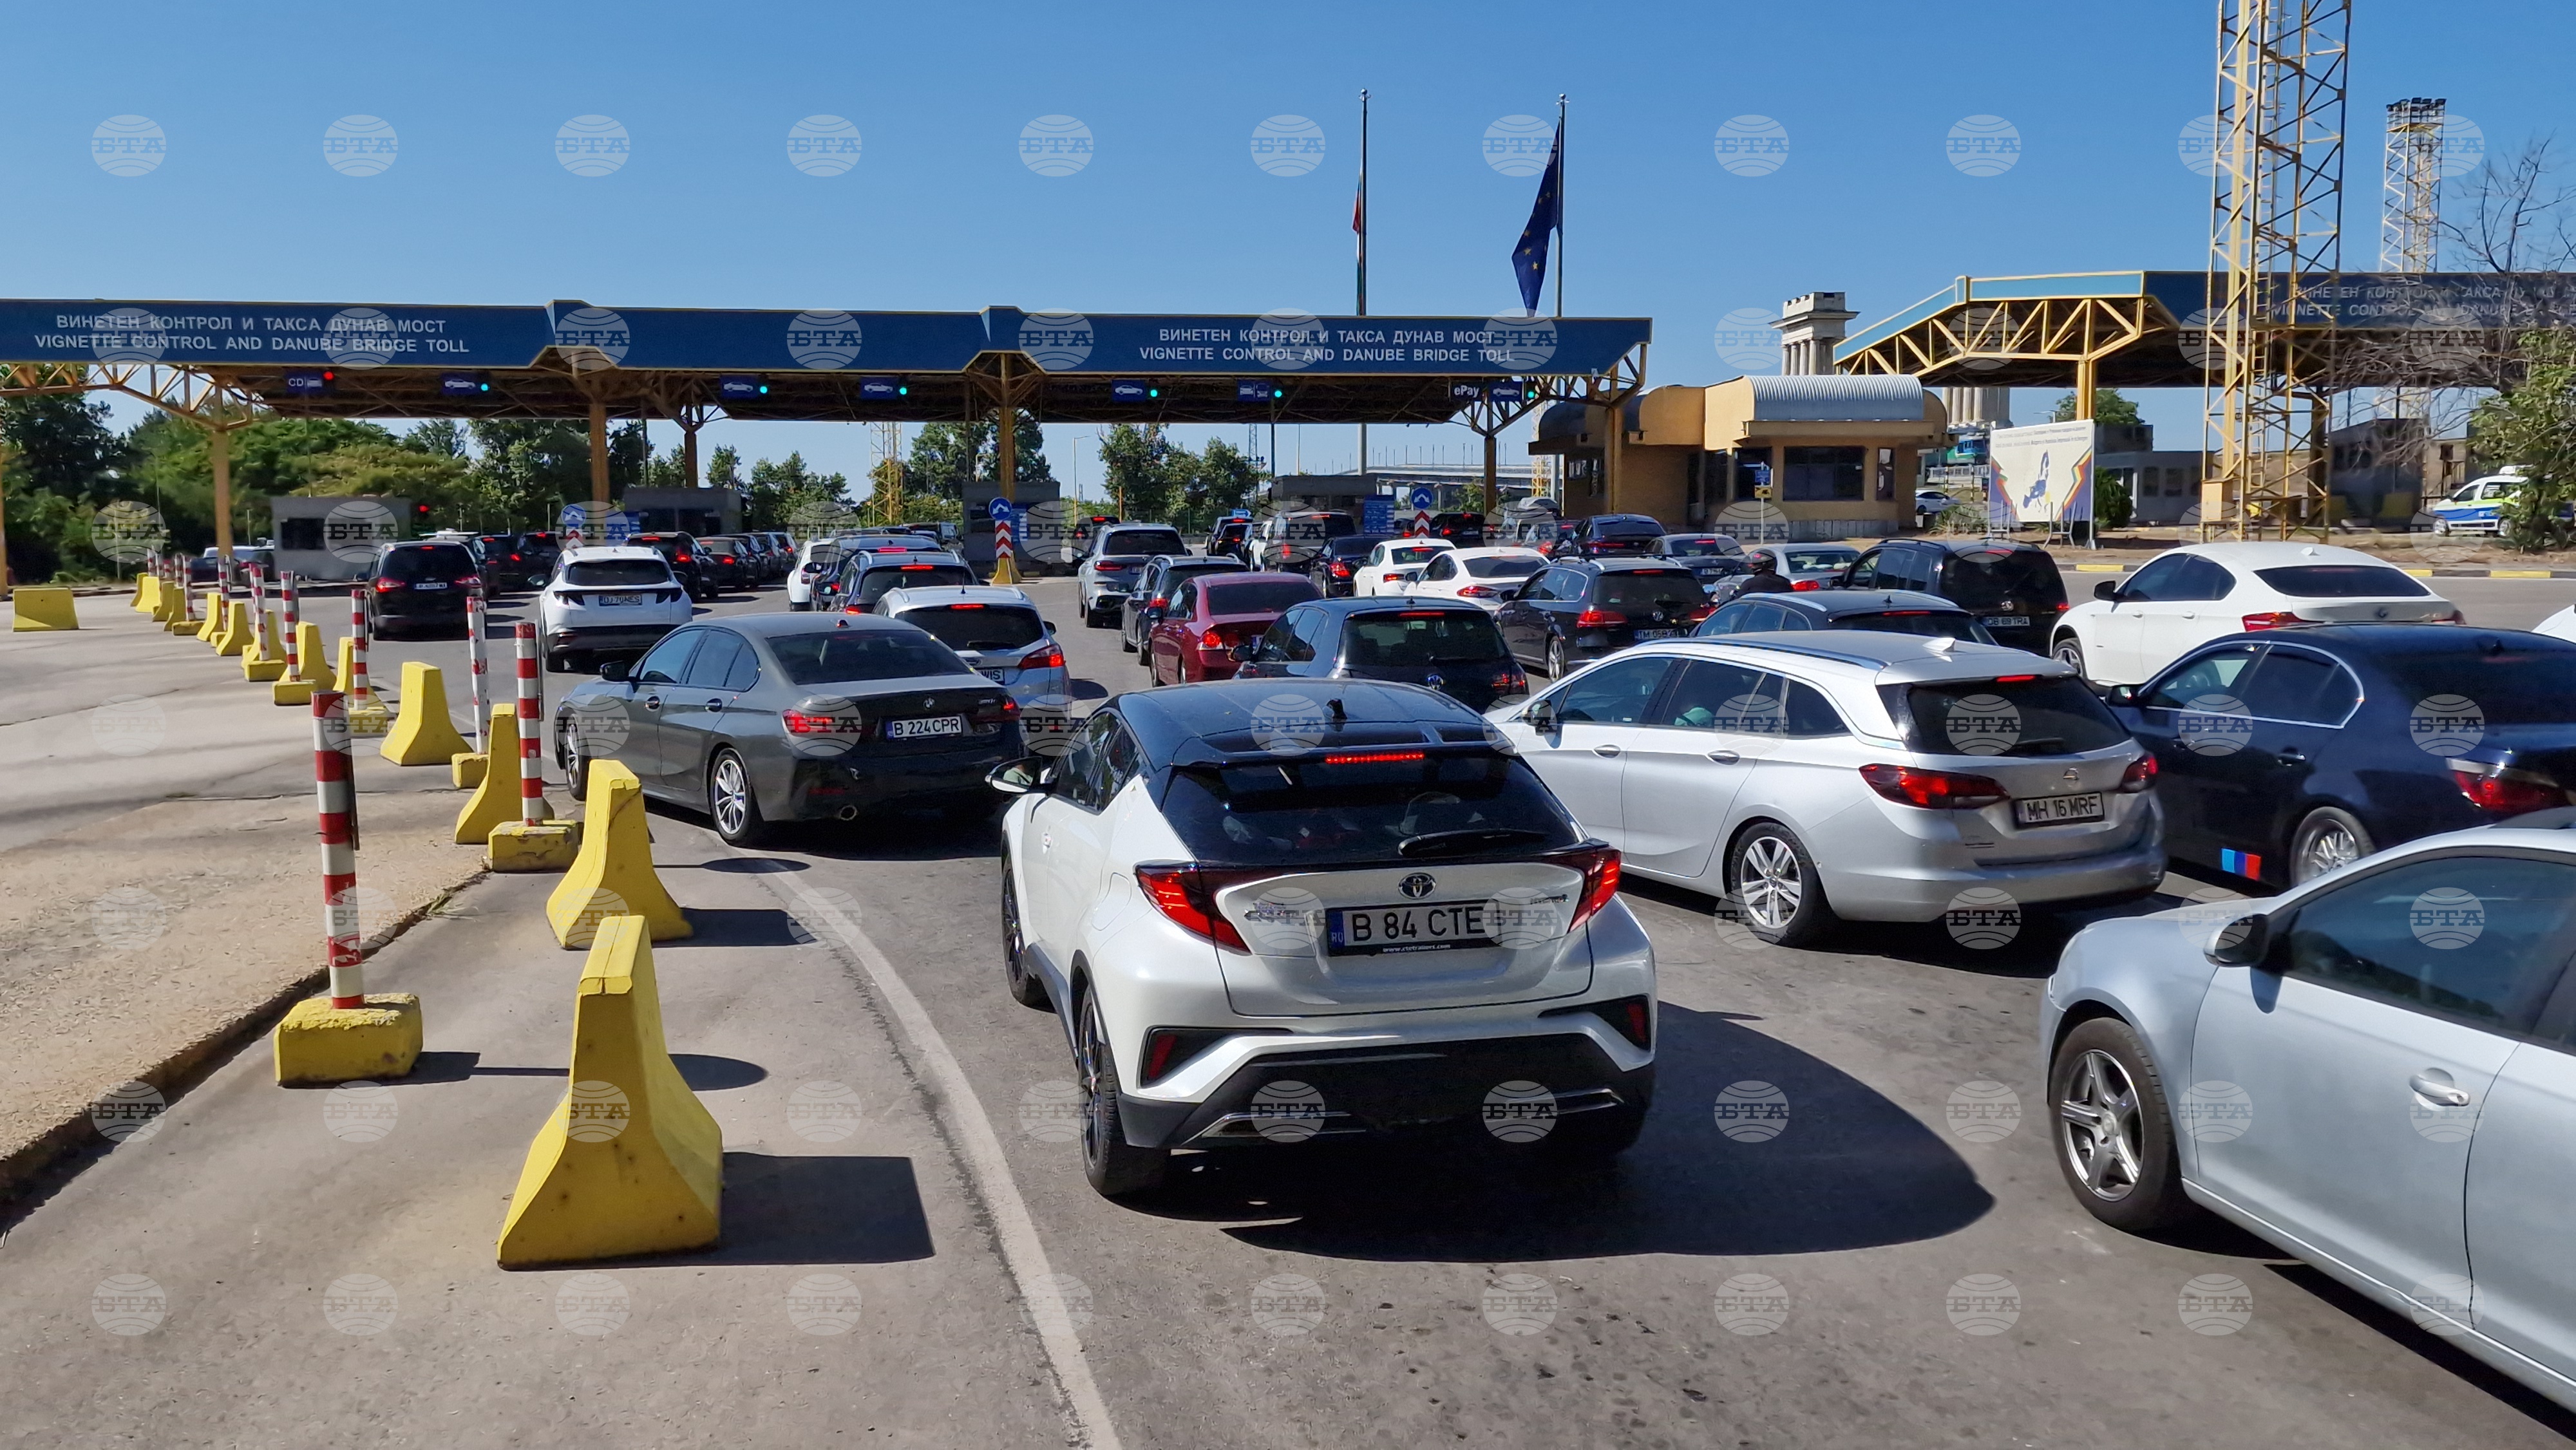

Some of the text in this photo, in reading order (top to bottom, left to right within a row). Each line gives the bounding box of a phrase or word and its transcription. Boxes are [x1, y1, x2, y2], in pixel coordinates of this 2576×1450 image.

[57, 315, 446, 334] ВИНЕТЕН КОНТРОЛ И ТАКСА ДУНАВ МОСТ
[35, 335, 469, 353] VIGNETTE CONTROL AND DANUBE BRIDGE TOLL
[1159, 329, 1495, 346] ВИНЕТЕН КОНТРОЛ И ТАКСА ДУНАВ МОСТ
[1139, 347, 1515, 362] VIGNETTE CONTROL AND DANUBE BRIDGE TOLL
[289, 378, 303, 387] CD
[1454, 385, 1479, 398] ePay
[894, 719, 959, 736] B 224 CPR
[2027, 796, 2098, 820] MH 16 MRF
[1352, 906, 1486, 942] B 84 CTE
